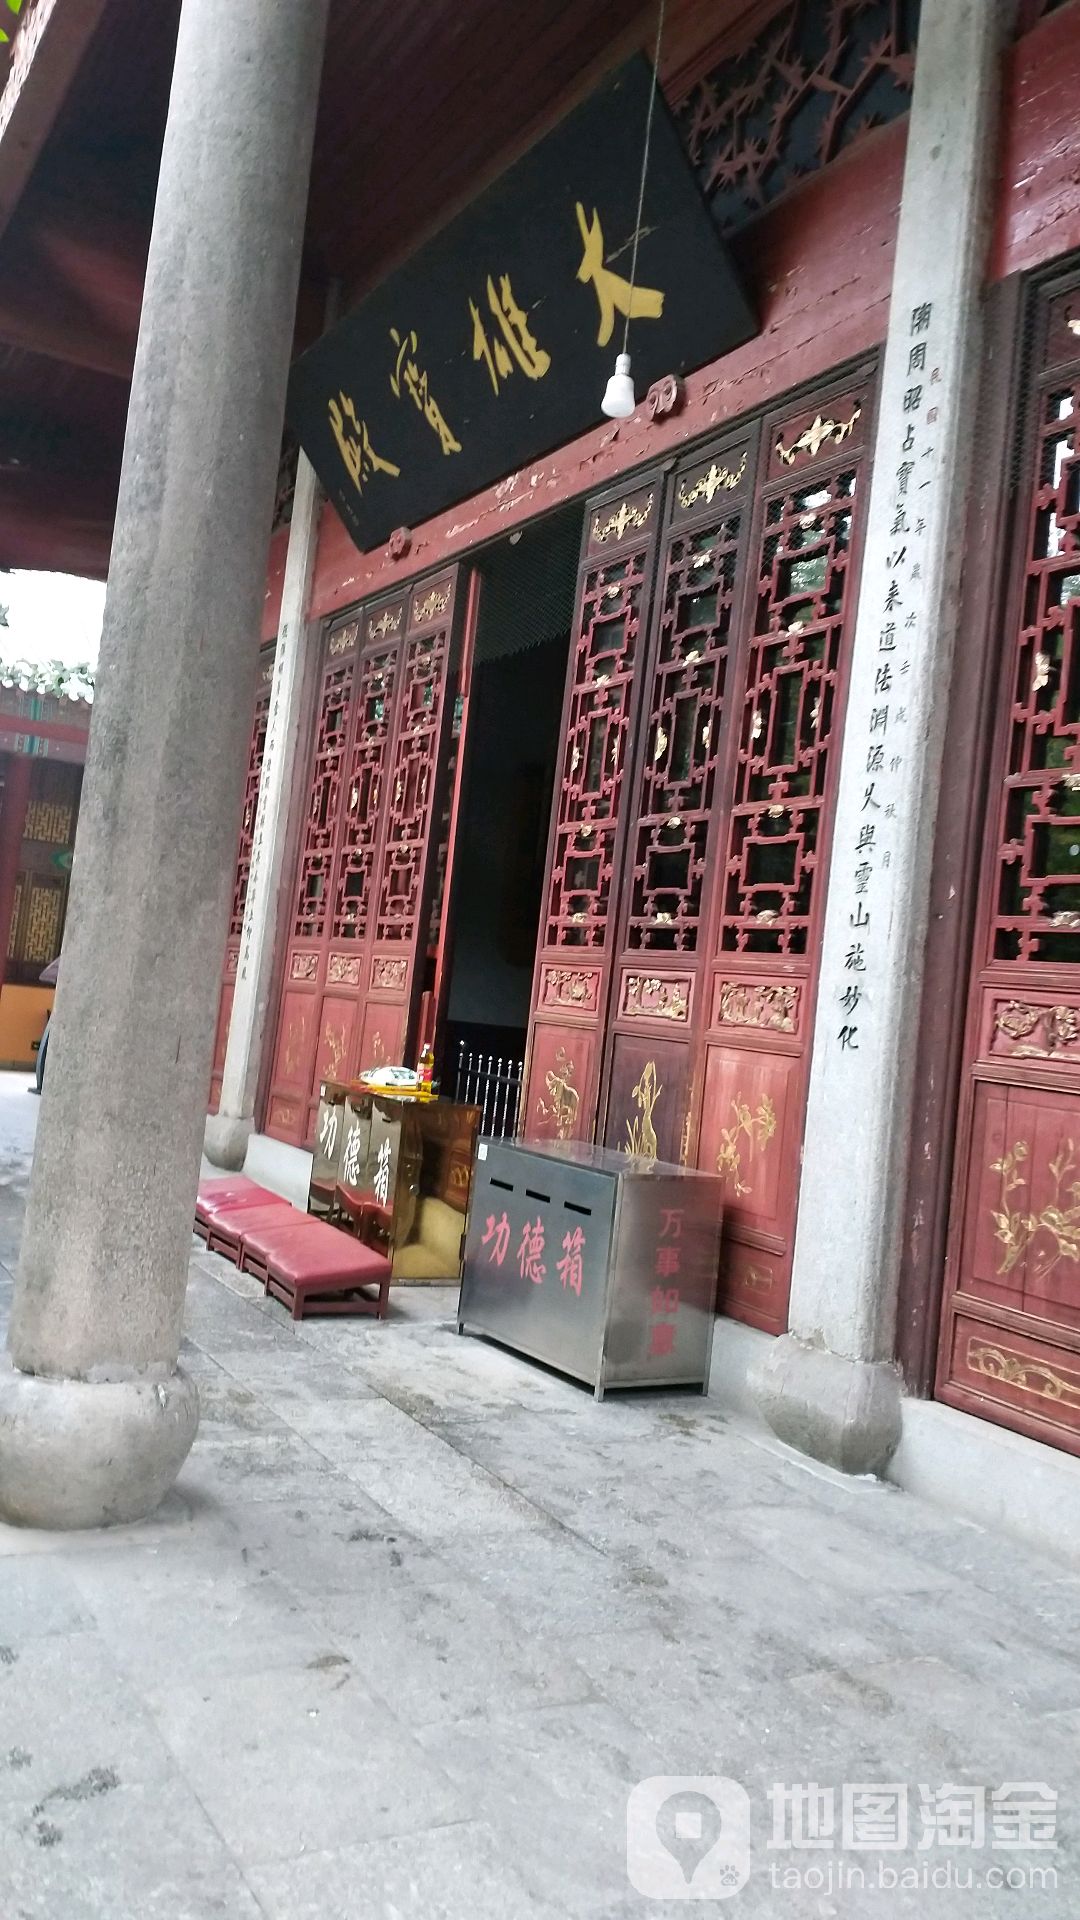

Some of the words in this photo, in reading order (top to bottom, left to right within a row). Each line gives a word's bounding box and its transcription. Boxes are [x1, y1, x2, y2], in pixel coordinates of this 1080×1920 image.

[320, 1105, 393, 1208] 功德箱
[481, 1211, 586, 1297] 功德箱
